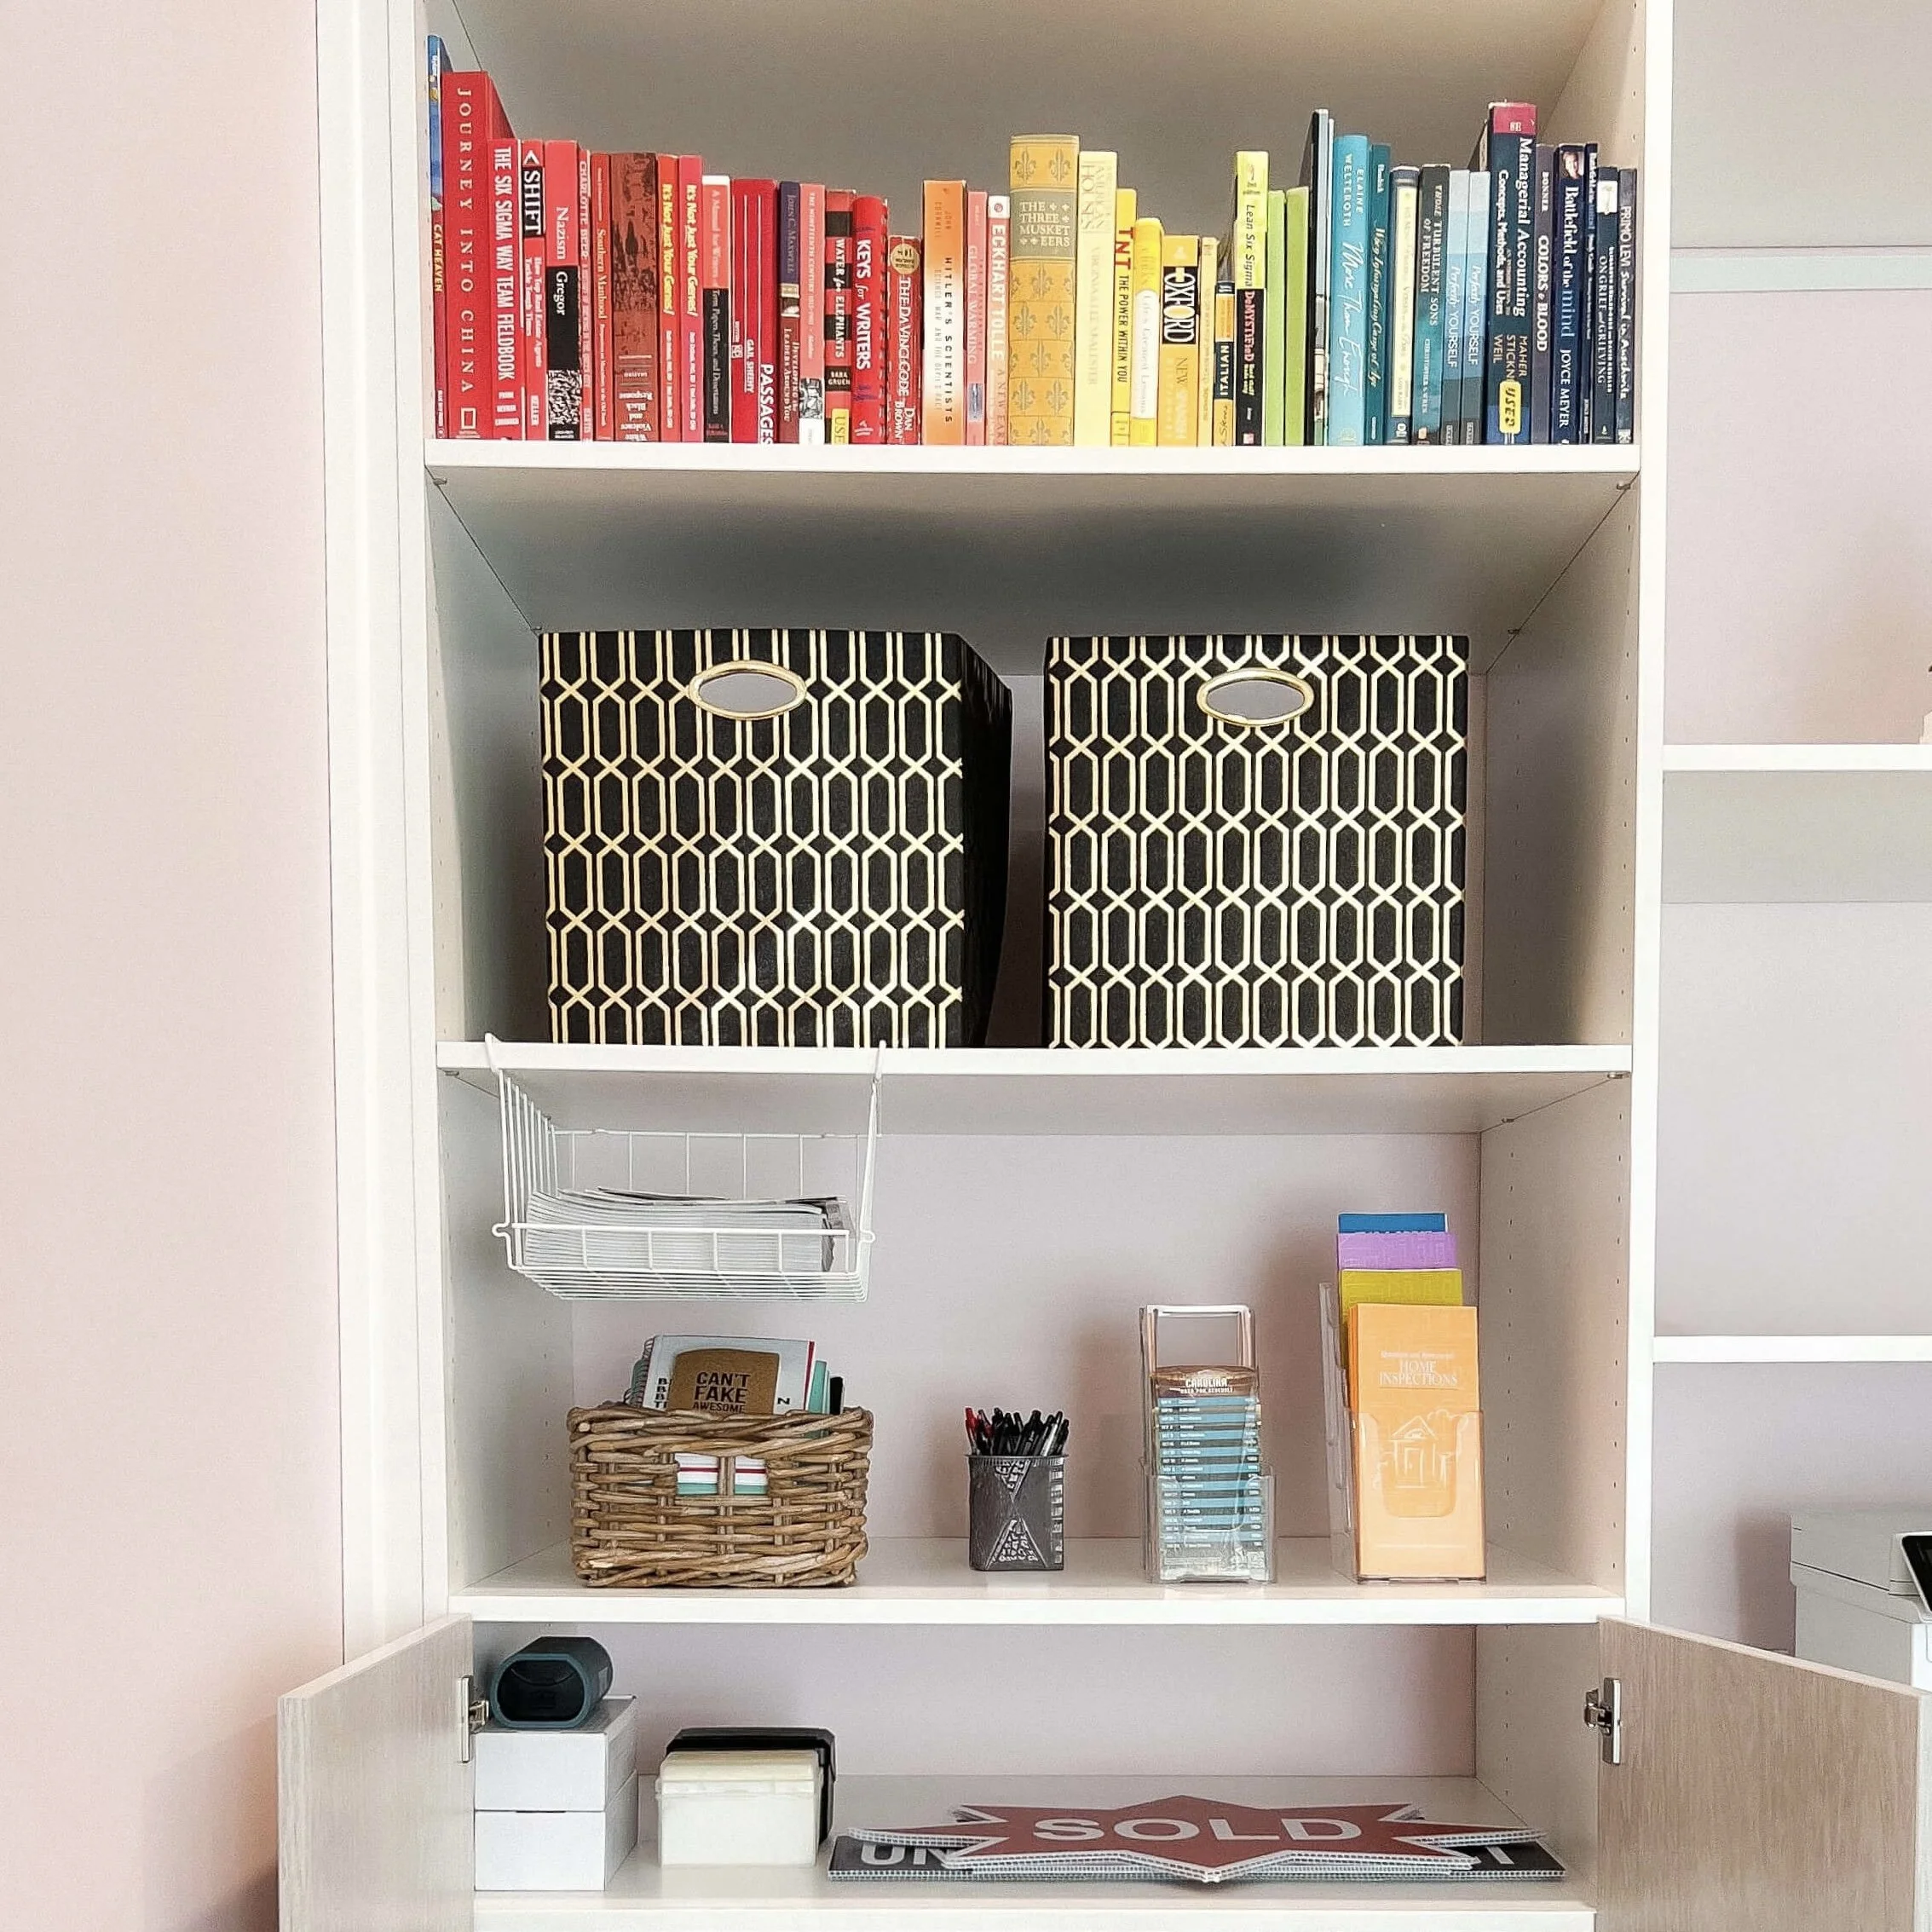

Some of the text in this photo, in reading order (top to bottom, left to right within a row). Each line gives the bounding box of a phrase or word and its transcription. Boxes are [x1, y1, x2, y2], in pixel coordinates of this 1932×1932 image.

[493, 147, 512, 171] THE
[1515, 136, 1533, 225] Managerial
[494, 176, 513, 196] SIX
[522, 170, 542, 236] SHIFT
[579, 160, 589, 224] CHARLOTTE
[662, 183, 673, 200] It's
[686, 185, 697, 201] It's
[1020, 202, 1046, 212] THE
[1081, 164, 1095, 230] HOUSES
[1343, 153, 1353, 227] WELTEROTH
[1355, 168, 1364, 214] ELAINE
[494, 200, 513, 240] SIGMA
[554, 205, 570, 260] Nazism
[663, 201, 674, 224] Not
[686, 202, 698, 225] Not
[1019, 224, 1070, 235] MUSKET
[1020, 213, 1058, 223] THREE
[433, 224, 444, 292] CAT HEAVEN
[457, 88, 475, 392] JOURNEY INTO CHINA
[496, 245, 514, 271] WAY
[580, 228, 590, 259] BEER
[597, 228, 608, 272] Southern
[663, 248, 674, 274] Your
[835, 239, 845, 275] WATER
[1041, 236, 1070, 247] EERS
[1115, 227, 1135, 270] TNT
[1243, 205, 1255, 287] Lean Six Sigma
[1432, 221, 1443, 293] TURBULENT
[1496, 170, 1509, 315] Concepts, Methods, and Uses
[1537, 171, 1549, 352] BONNER COLORS BLOOD
[686, 249, 699, 276] Your
[991, 224, 1006, 305] ECKHART
[1421, 234, 1432, 293] FREEDOM
[1512, 228, 1531, 317] Accounting
[496, 276, 515, 308] TEAM
[552, 272, 568, 315] Gregor
[597, 274, 609, 319] Manhood
[662, 274, 675, 315] Genes!
[685, 276, 699, 317] Genes!
[854, 239, 872, 371] KEYS for WRITERS
[898, 277, 912, 304] THE
[967, 245, 978, 365] GLOBAL WARMING
[1429, 297, 1439, 326] SONS
[1559, 186, 1579, 429] Battlefield of the mind JOYCE MEYER
[1618, 205, 1633, 400] PRIMO LEVI Survival in Auschwitz
[834, 296, 845, 358] ELEPHANTS
[990, 309, 1006, 359] TOLLE
[1116, 274, 1129, 383] THE POWER WITHIN YOU
[1332, 241, 1365, 398] More Than Enough
[1446, 264, 1461, 368] Perfectly YOURSELF
[1468, 264, 1482, 366] Perfectly YOURSELF
[1597, 256, 1608, 384] ON GRIEF GRIEVING
[497, 314, 516, 381] FIELDBOOK
[746, 339, 754, 359] GAIL
[898, 325, 912, 359] VINCI
[943, 257, 953, 424] HITLER'S SCIENTISTS
[1493, 333, 1503, 364] WEIL
[1518, 335, 1528, 378] MAHER
[783, 328, 793, 422] LEADERS AROUND YOU
[898, 360, 913, 396] CODE
[1175, 357, 1188, 386] NEW
[1219, 344, 1231, 395] ITALIAN
[759, 363, 775, 444] PASSAGES
[894, 401, 904, 439] BROWN
[904, 407, 916, 432] DAN
[696, 1371, 751, 1387] CAN'T
[1380, 1371, 1458, 1386] INSPECTIONS
[1399, 1359, 1437, 1372] HOME
[693, 1402, 746, 1414] AWESOME
[695, 1386, 747, 1404] FAKE
[1033, 1817, 1363, 1842] SOLD
